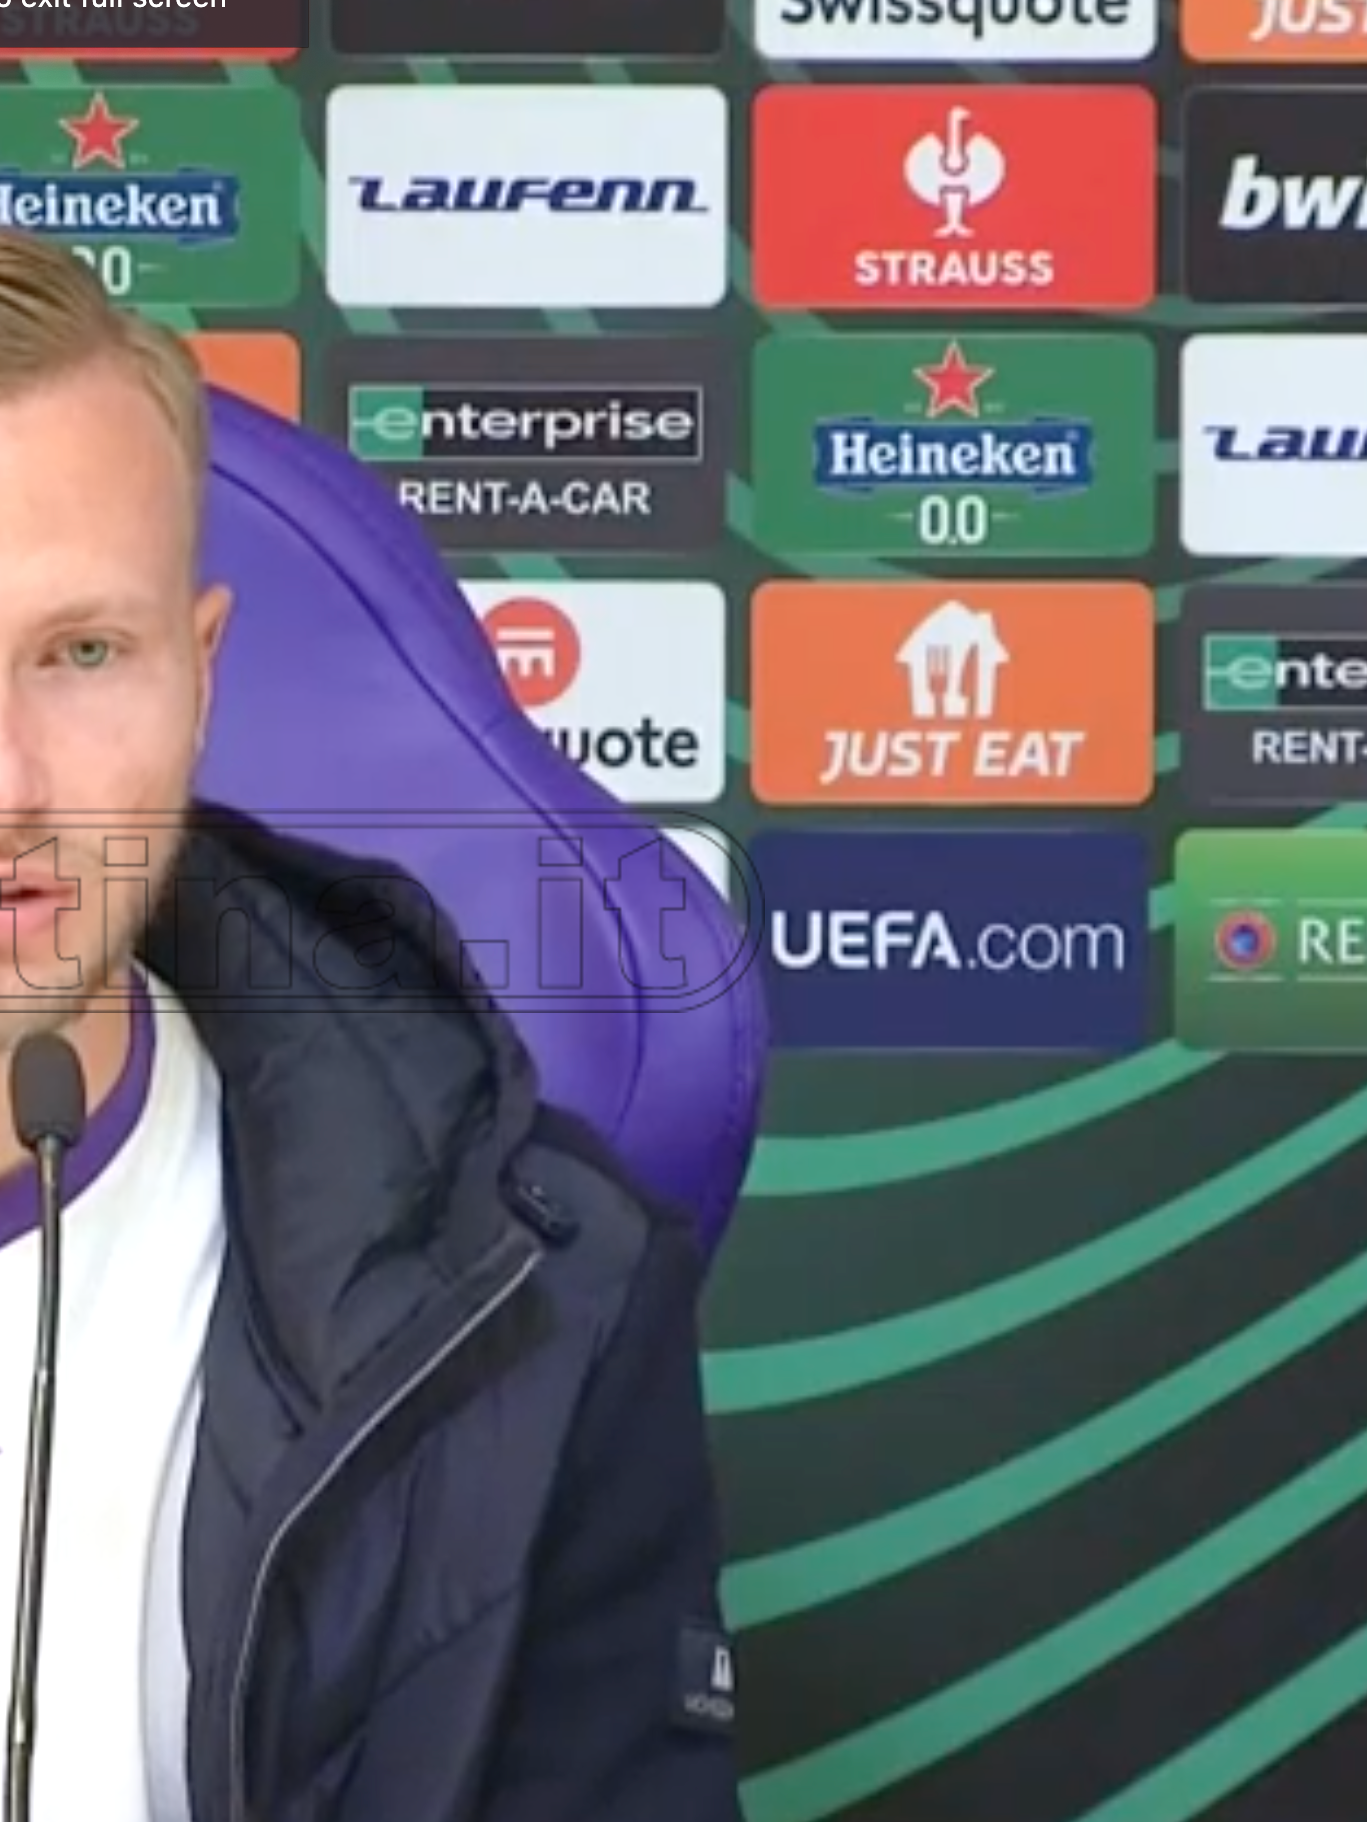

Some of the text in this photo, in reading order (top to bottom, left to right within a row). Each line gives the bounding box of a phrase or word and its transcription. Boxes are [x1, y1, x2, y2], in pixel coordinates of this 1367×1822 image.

[1249, 0, 1367, 41] JUS
[854, 250, 1055, 287] STRAUSS
[372, 400, 695, 450] enterprise
[1202, 425, 1367, 463] Lau
[829, 430, 1077, 476] Heineken
[398, 479, 652, 516] RENT-A-CAR
[919, 493, 988, 546] 0.0
[544, 716, 700, 769] uote
[819, 729, 1086, 784] JUST EAT
[771, 910, 1126, 970] UEFA.com
